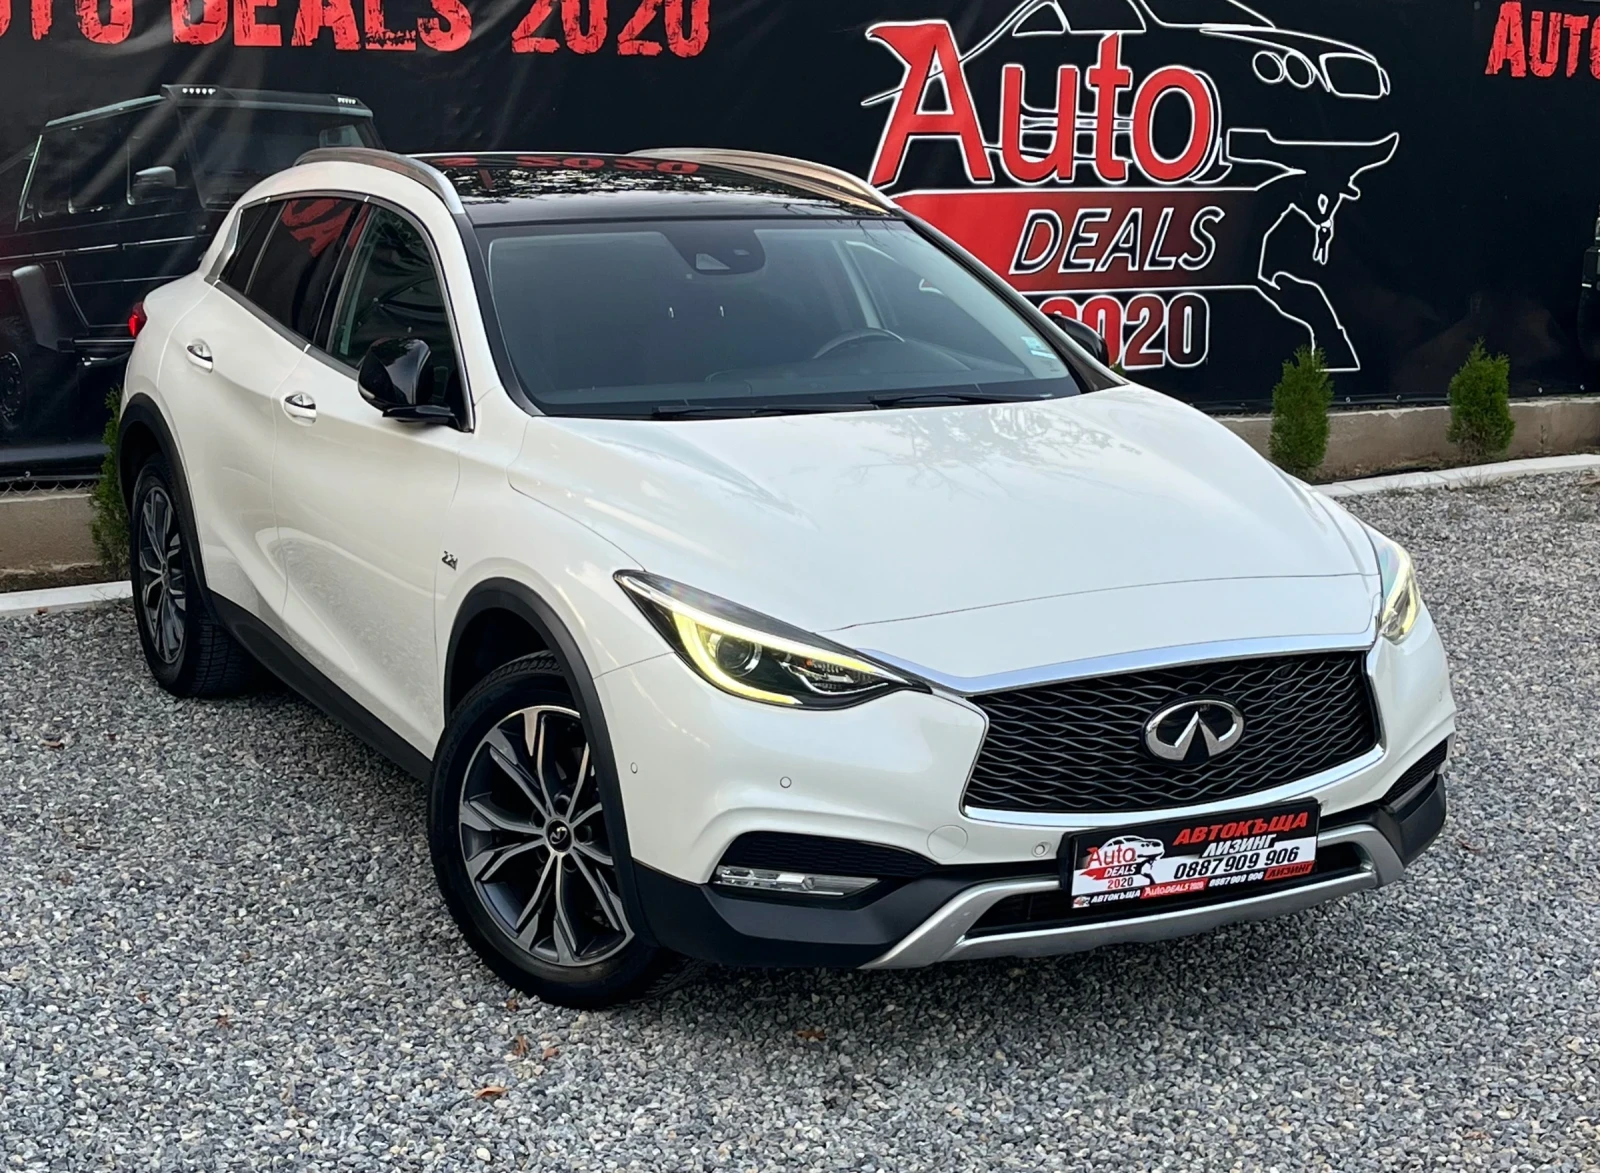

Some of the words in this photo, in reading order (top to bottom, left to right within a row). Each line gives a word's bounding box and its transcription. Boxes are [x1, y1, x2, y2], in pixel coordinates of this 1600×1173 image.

[171, 0, 472, 51] DEALS
[512, 0, 710, 57] 2020
[866, 20, 1213, 187] Auto
[1009, 206, 1226, 275] DEALS
[1172, 811, 1309, 846] АВТОКЪЩА
[1201, 833, 1277, 858] ЛИЗИНГ
[1086, 843, 1137, 869] Auto
[1103, 864, 1137, 878] DEALS
[1173, 858, 1224, 880] 0887
[1223, 852, 1261, 873] 909
[1264, 846, 1300, 866] 906
[1107, 876, 1134, 890] 2020
